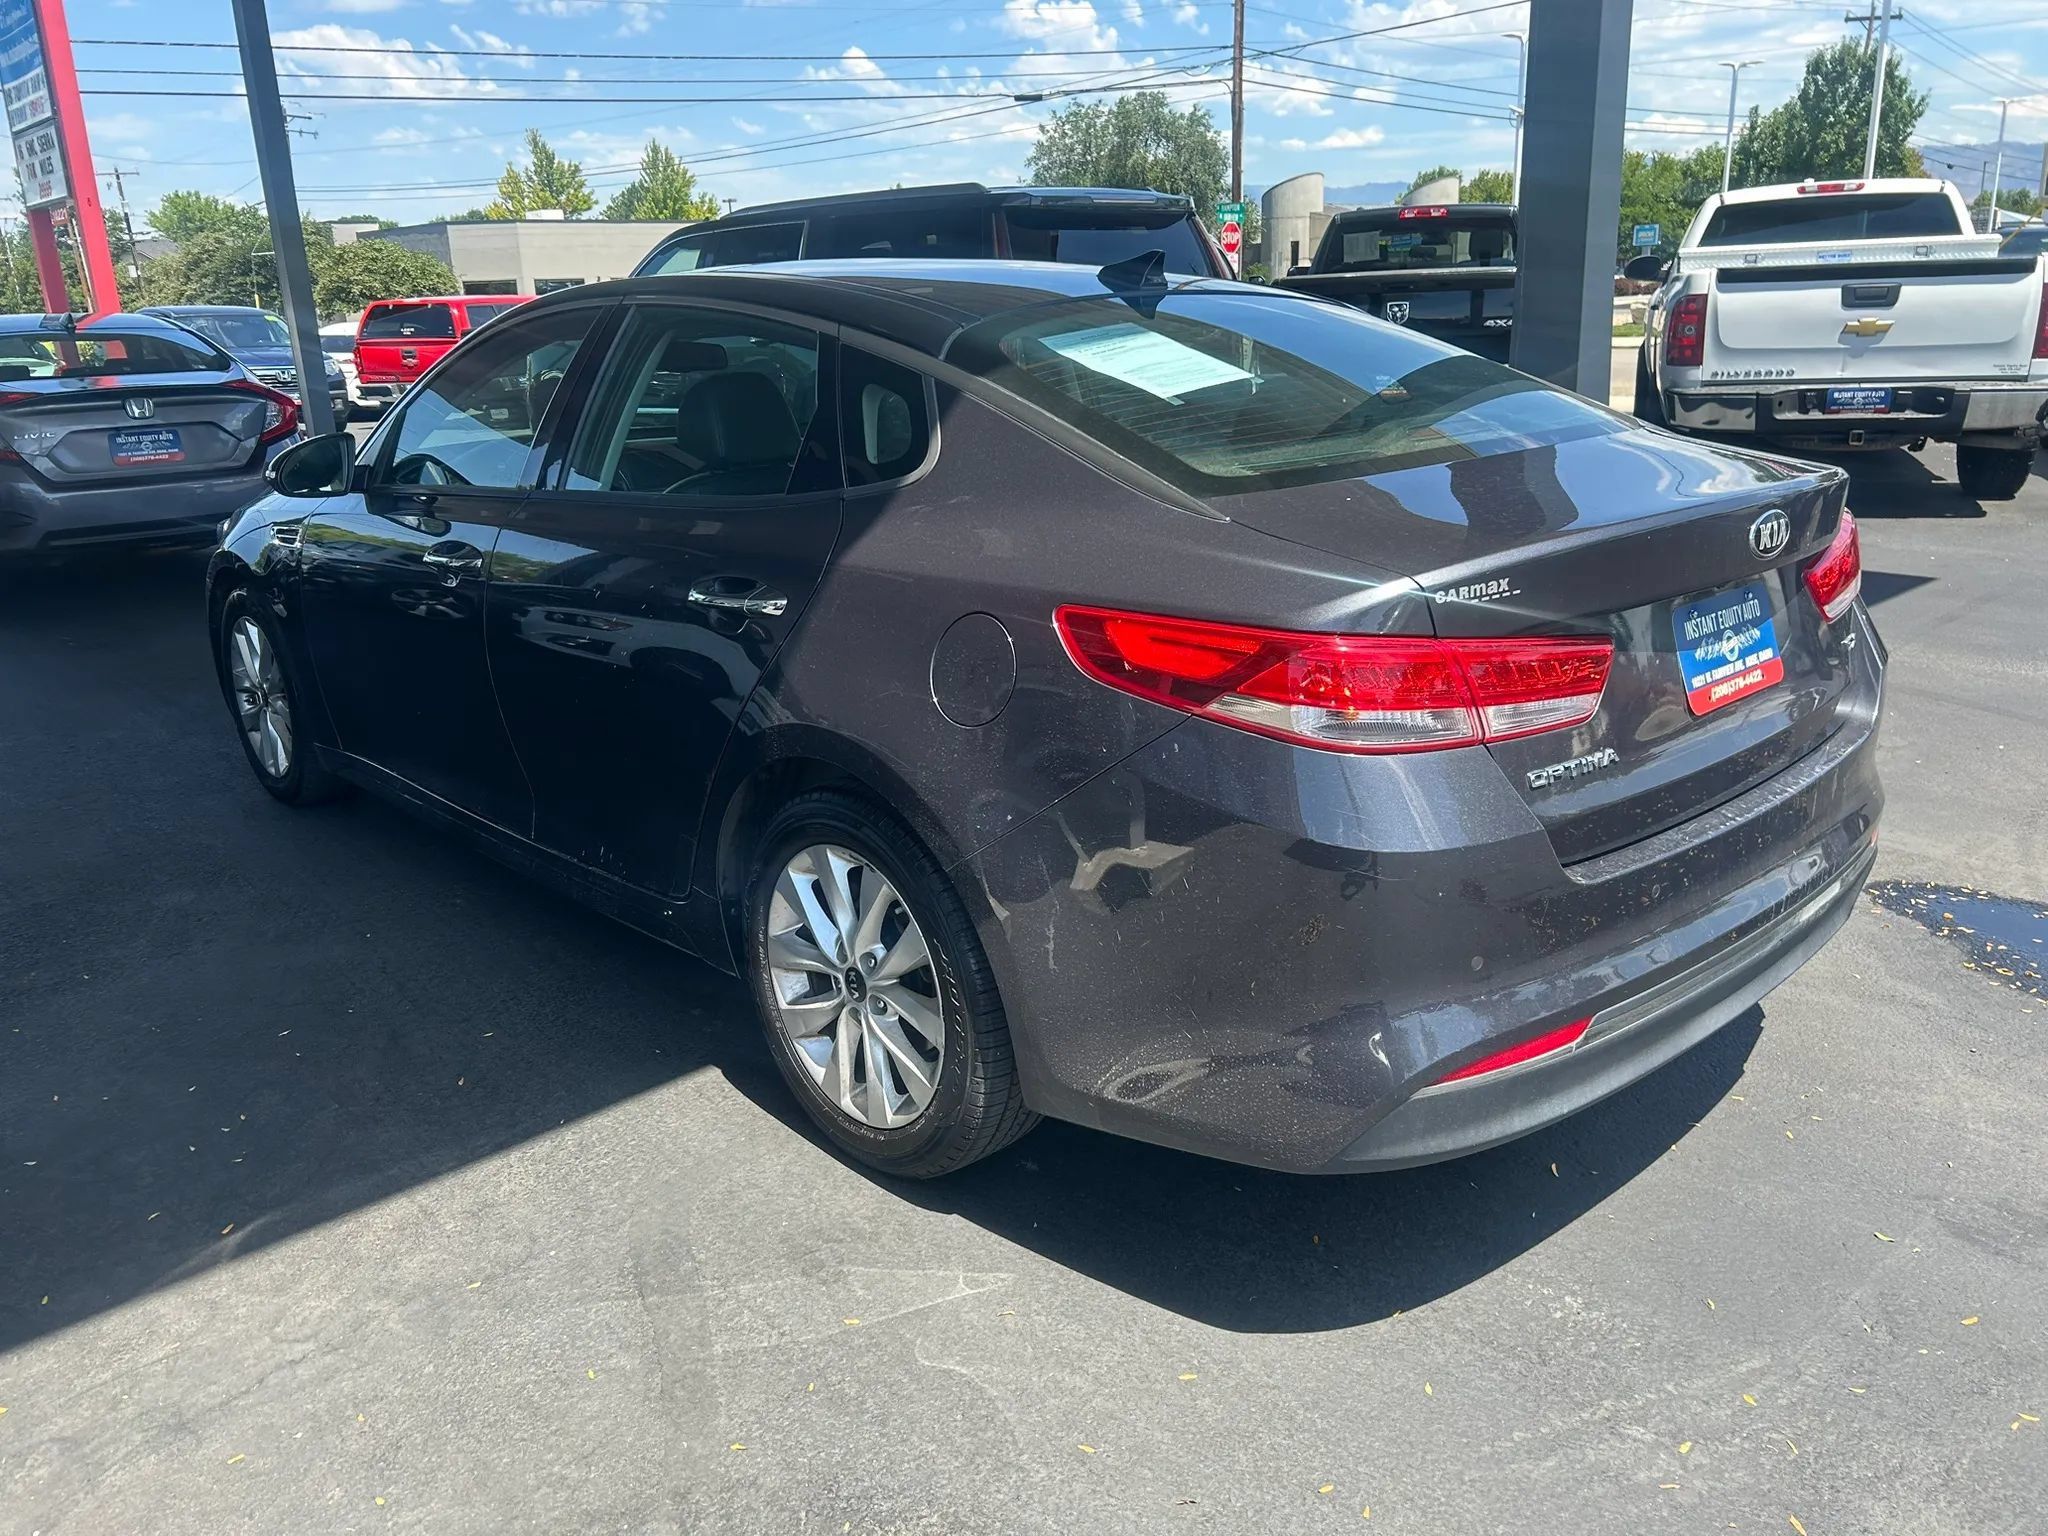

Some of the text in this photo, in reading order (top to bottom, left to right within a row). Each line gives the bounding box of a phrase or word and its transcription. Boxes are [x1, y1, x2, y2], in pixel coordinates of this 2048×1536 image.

[1222, 231, 1240, 245] STOP
[1710, 369, 1796, 380] SILVERADO
[14, 432, 56, 440] CIVIC
[115, 434, 139, 444] INSTANT
[140, 434, 159, 442] EQUITY
[1759, 518, 1787, 550] KIA
[1684, 599, 1761, 641] INSTANT EQUITY AUTO
[1526, 747, 1620, 789] OPTIMA
